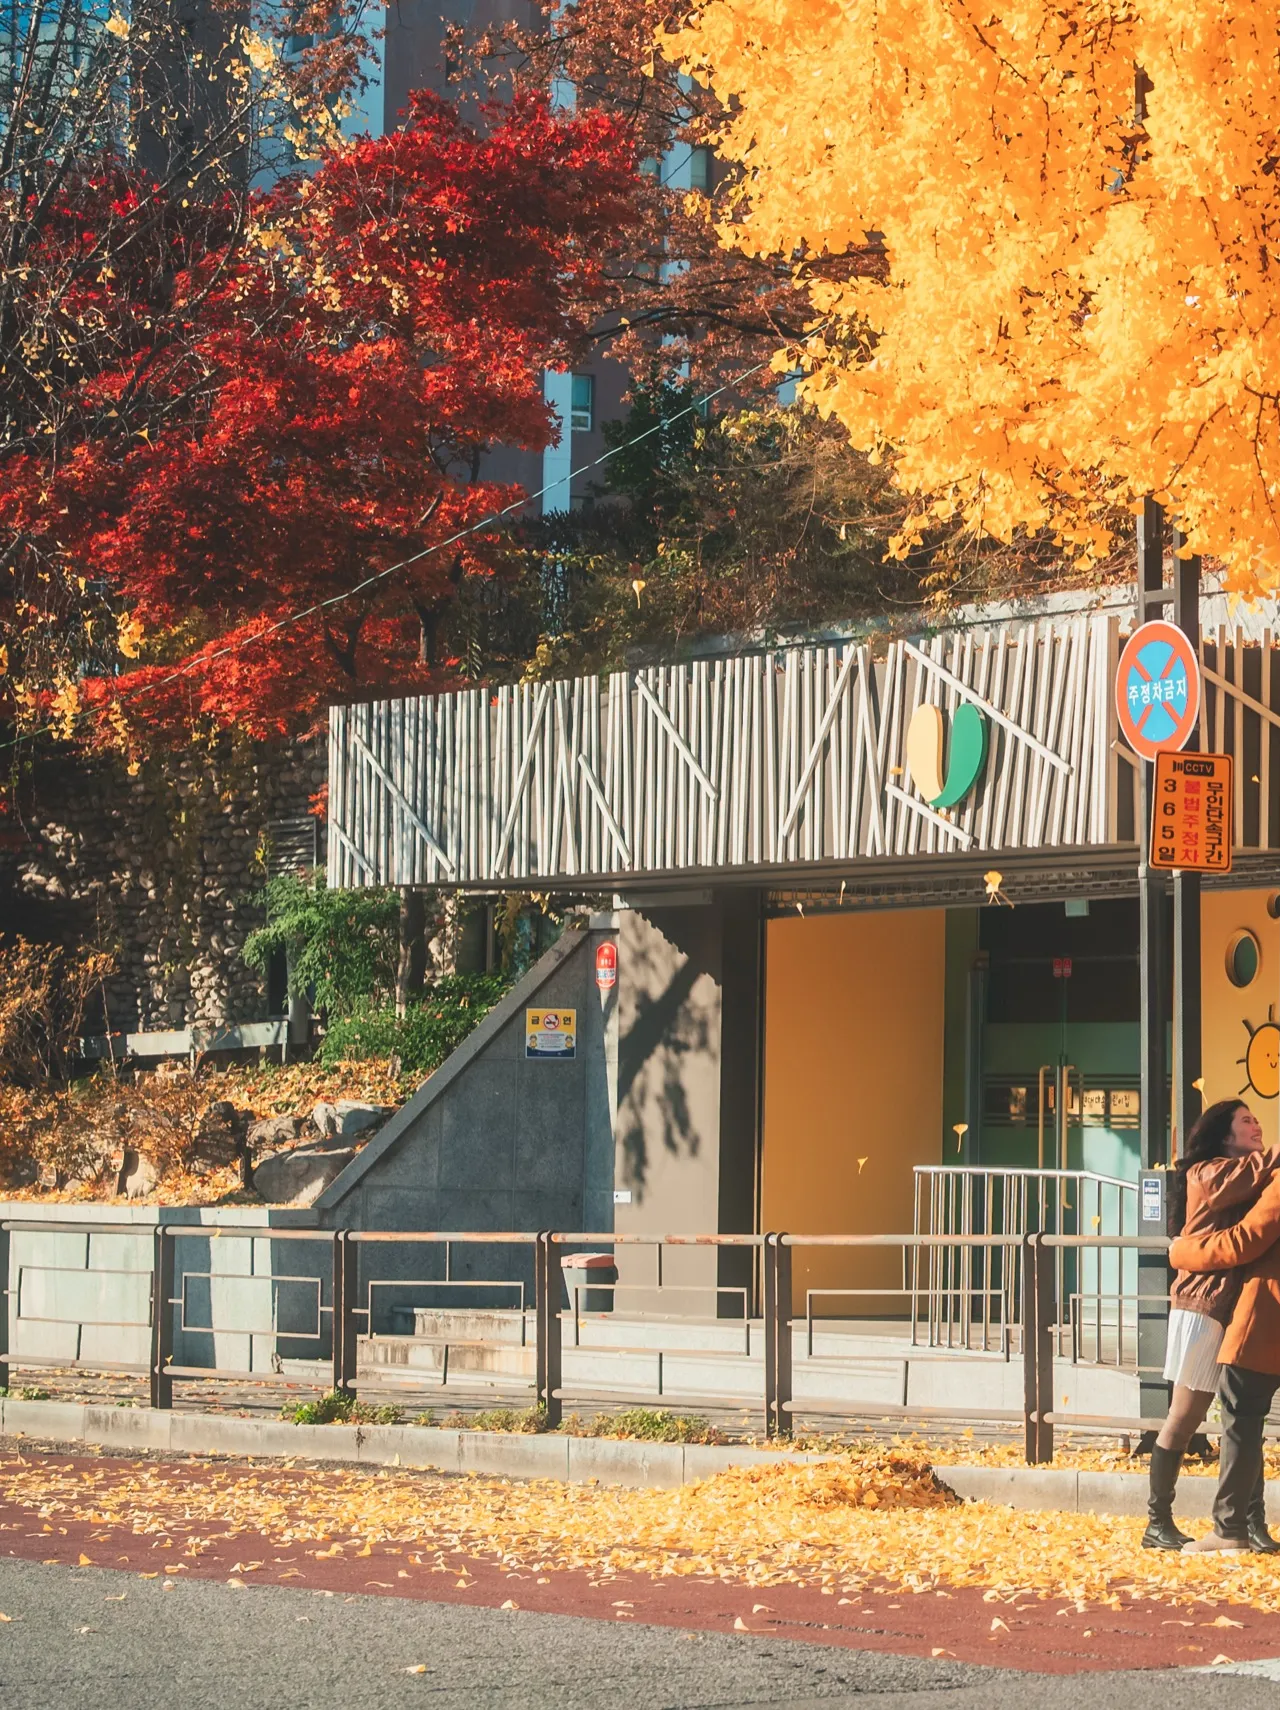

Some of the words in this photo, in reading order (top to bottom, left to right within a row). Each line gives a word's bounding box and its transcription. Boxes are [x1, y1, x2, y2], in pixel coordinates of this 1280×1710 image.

[1128, 676, 1187, 706] 주정차금지
[1185, 762, 1213, 773] CCTV
[1205, 782, 1224, 864] 무인단속구간
